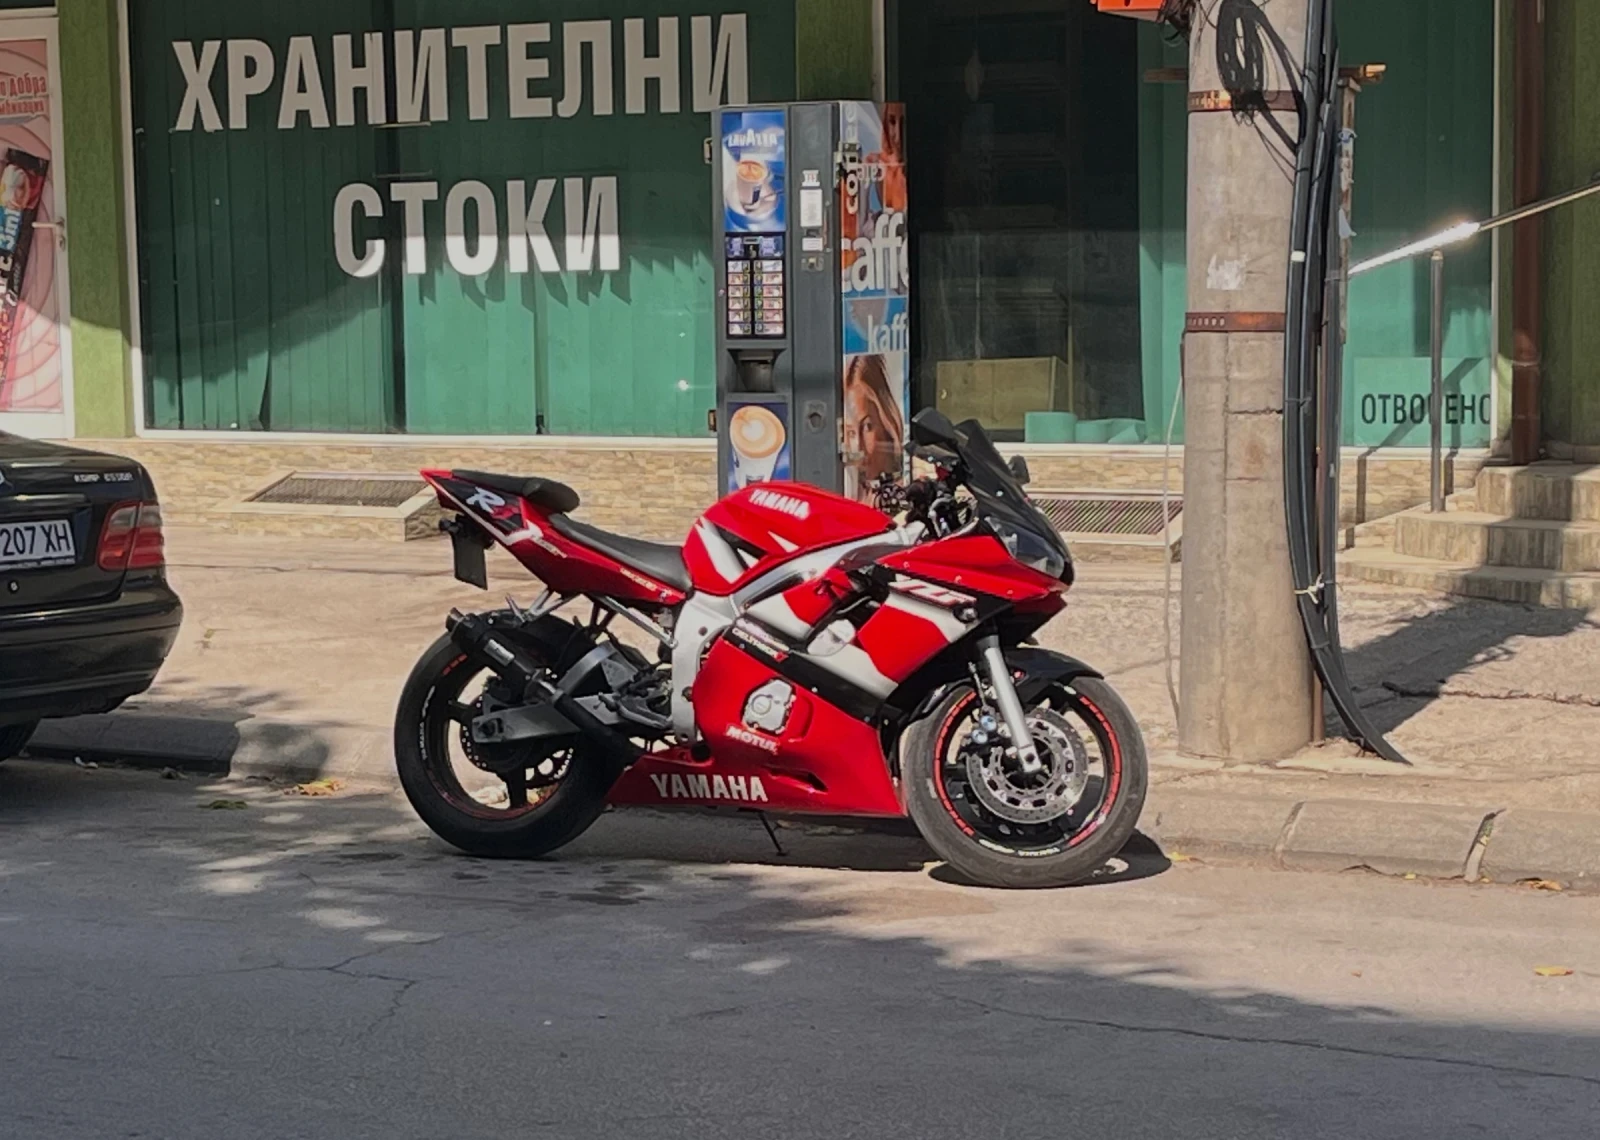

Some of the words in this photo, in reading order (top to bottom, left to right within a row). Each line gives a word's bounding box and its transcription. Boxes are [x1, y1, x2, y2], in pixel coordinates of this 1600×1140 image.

[173, 13, 749, 132] ХРАНИТЕЛНИ
[333, 176, 621, 278] СТОКИ
[1361, 393, 1490, 425] ОТВОЕНО
[748, 488, 810, 520] YAMAHA
[0, 526, 37, 557] 207
[650, 773, 768, 802] YAMAHA
